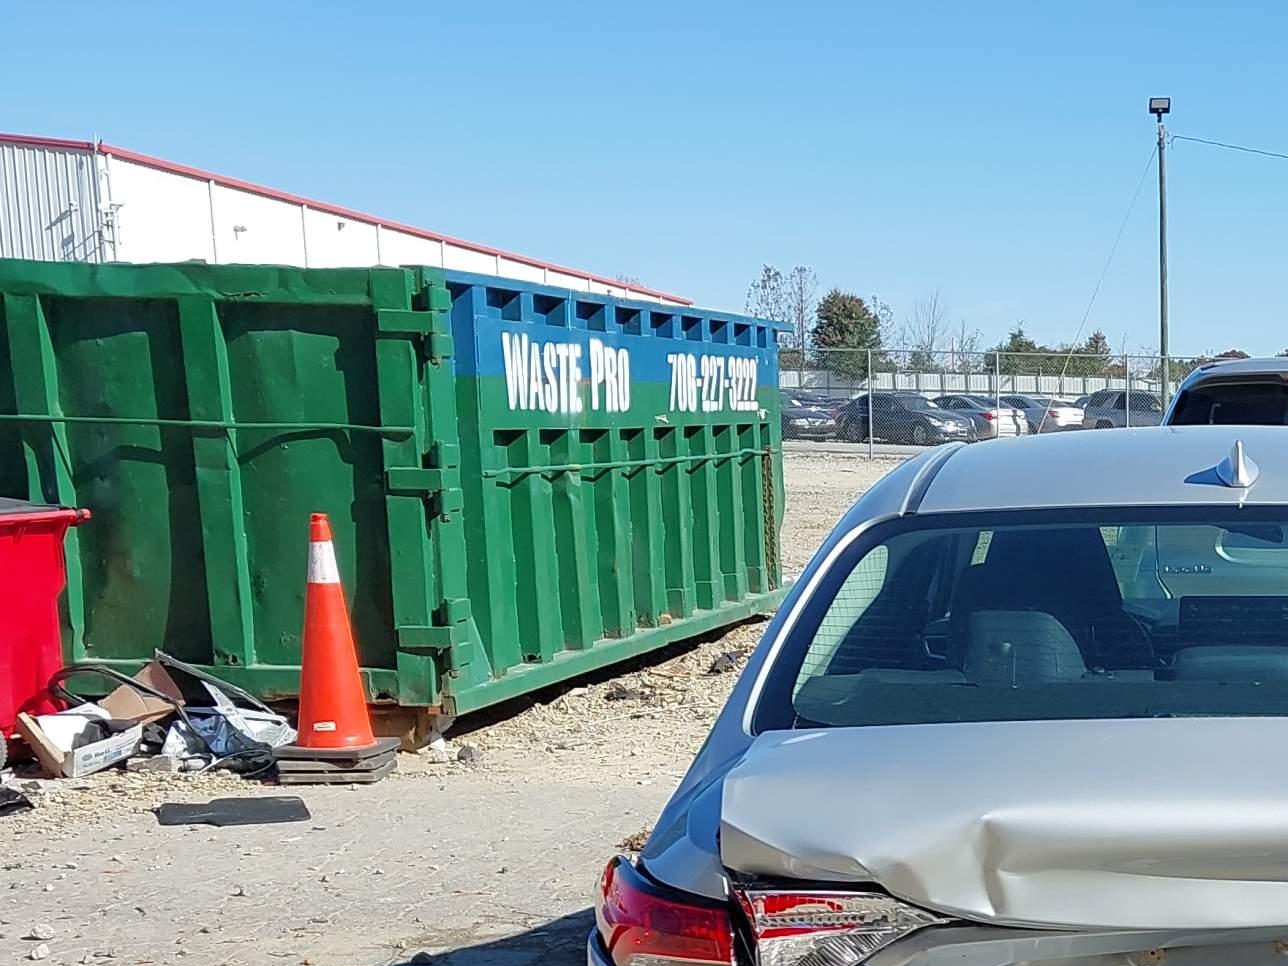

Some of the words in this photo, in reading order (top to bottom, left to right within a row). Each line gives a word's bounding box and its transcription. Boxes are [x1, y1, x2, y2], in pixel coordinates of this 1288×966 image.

[502, 332, 582, 413] WASTE
[589, 338, 630, 412] PRO
[667, 353, 759, 412] 706-227-3222
